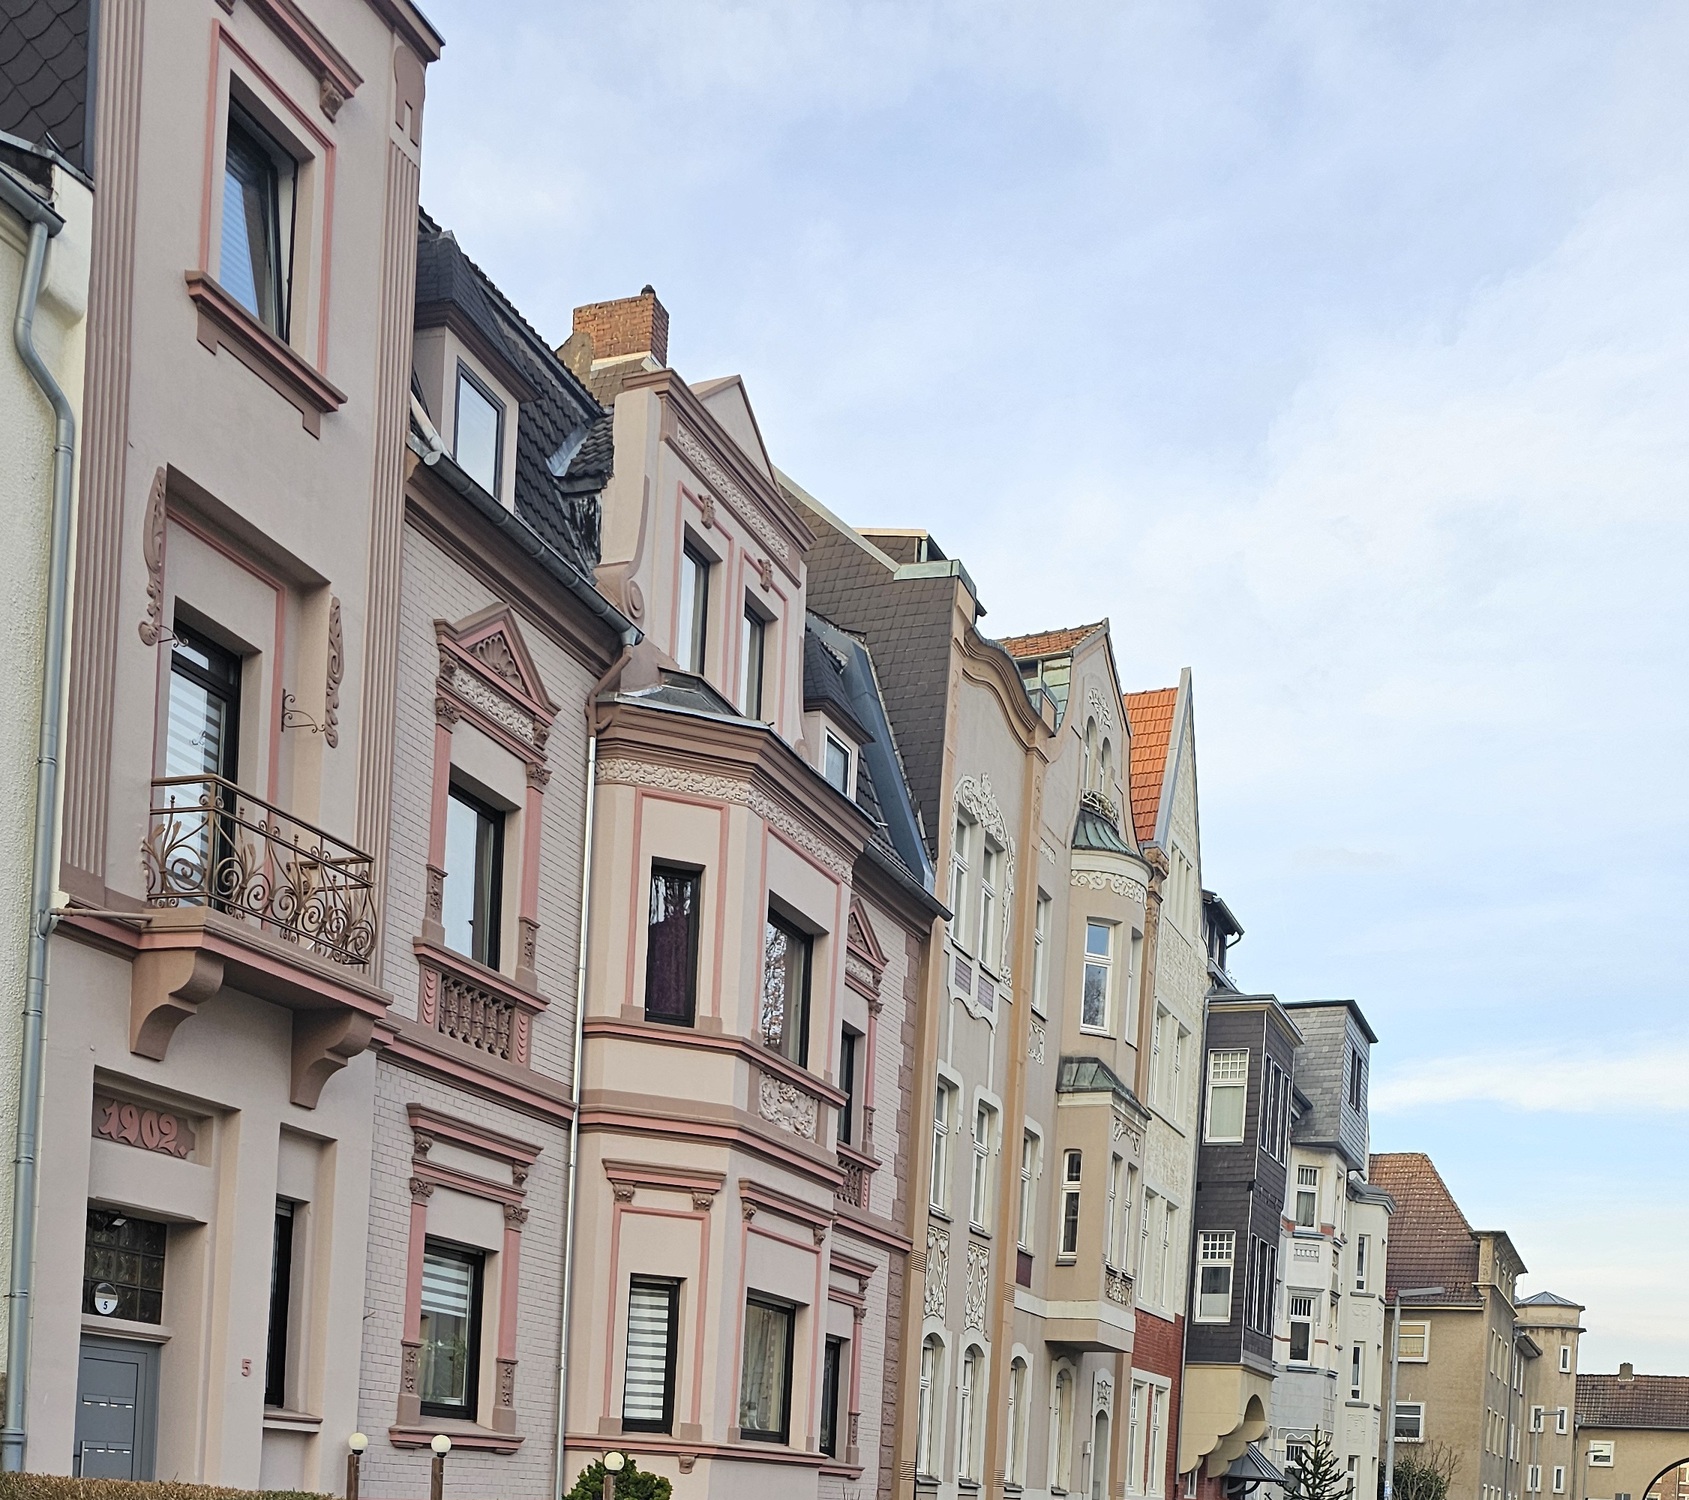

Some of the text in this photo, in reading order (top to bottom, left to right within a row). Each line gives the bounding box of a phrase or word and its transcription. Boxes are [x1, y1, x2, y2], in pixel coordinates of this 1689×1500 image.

[98, 1099, 187, 1158] 1902.
[103, 1300, 108, 1310] 5
[241, 1358, 252, 1377] 5
